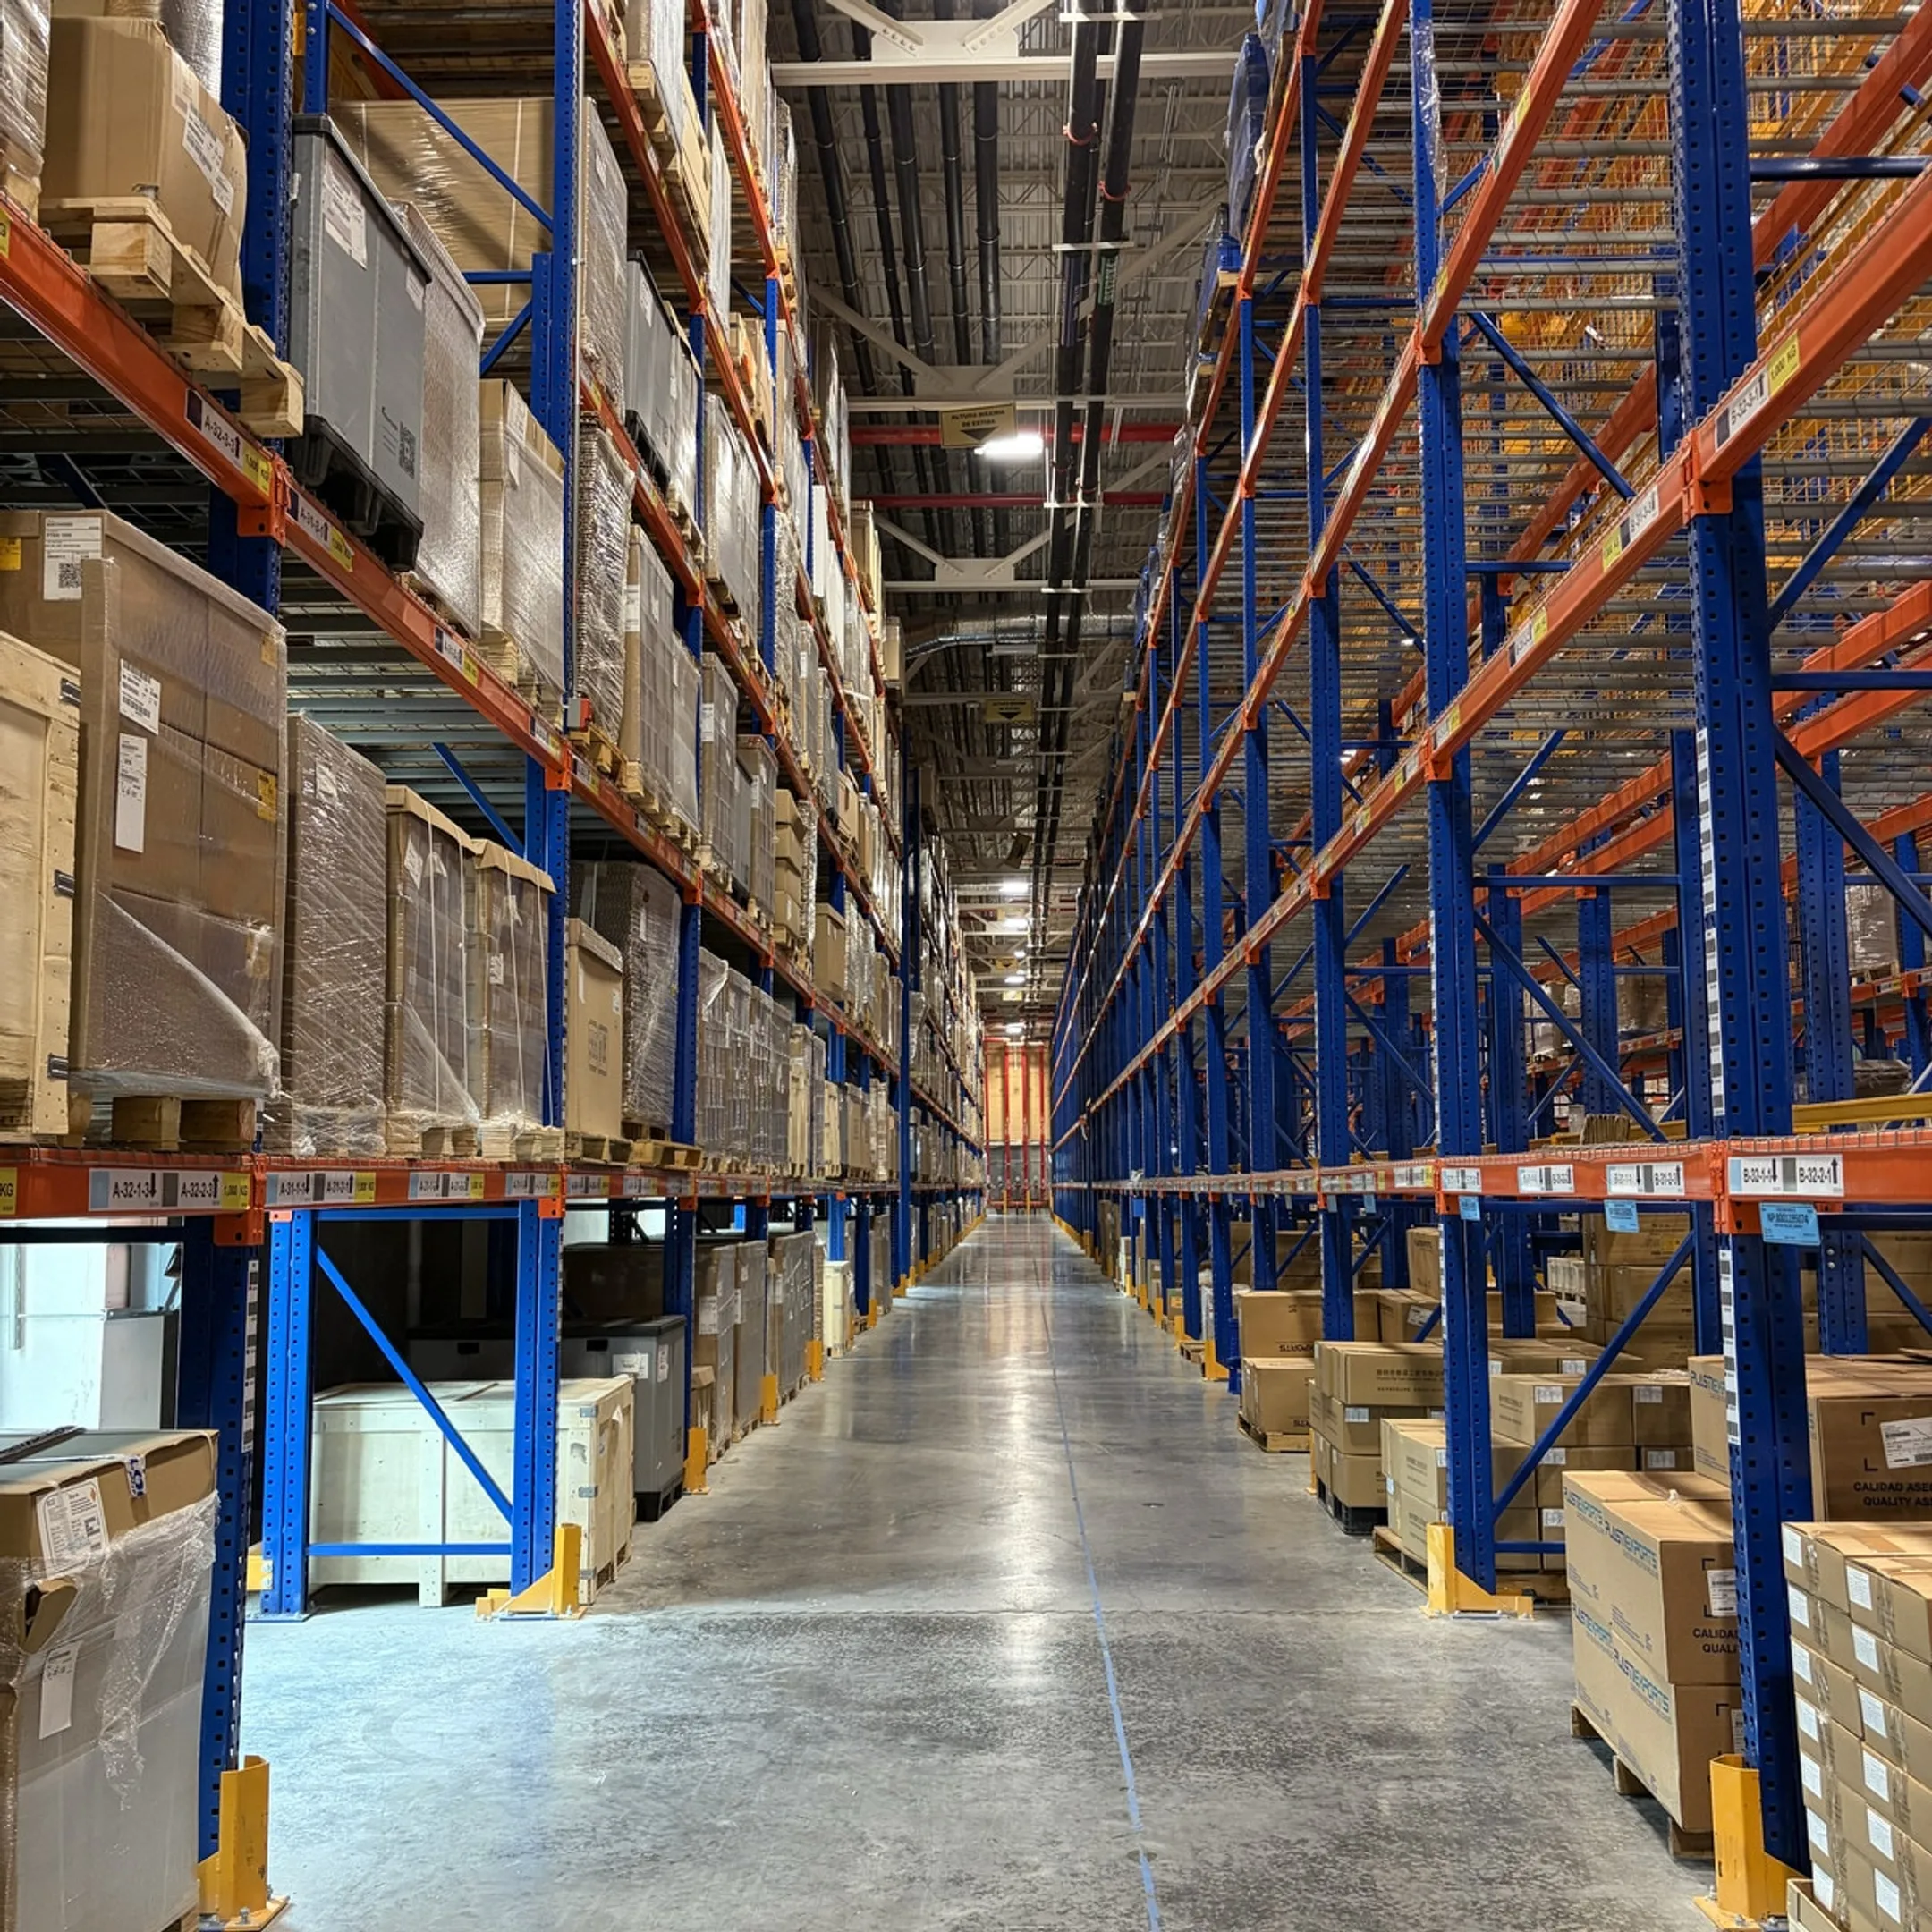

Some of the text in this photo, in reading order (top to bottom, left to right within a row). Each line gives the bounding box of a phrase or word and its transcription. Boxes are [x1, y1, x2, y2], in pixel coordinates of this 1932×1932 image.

[1799, 1166, 1832, 1184] B-32-2-1
[113, 1182, 149, 1199] A-32-1-3
[1853, 1481, 1932, 1492] CALIDAD ASE
[1863, 1496, 1911, 1506] QUALITY
[1692, 1627, 1739, 1639] CALIDA
[1702, 1642, 1737, 1654] QUALI
